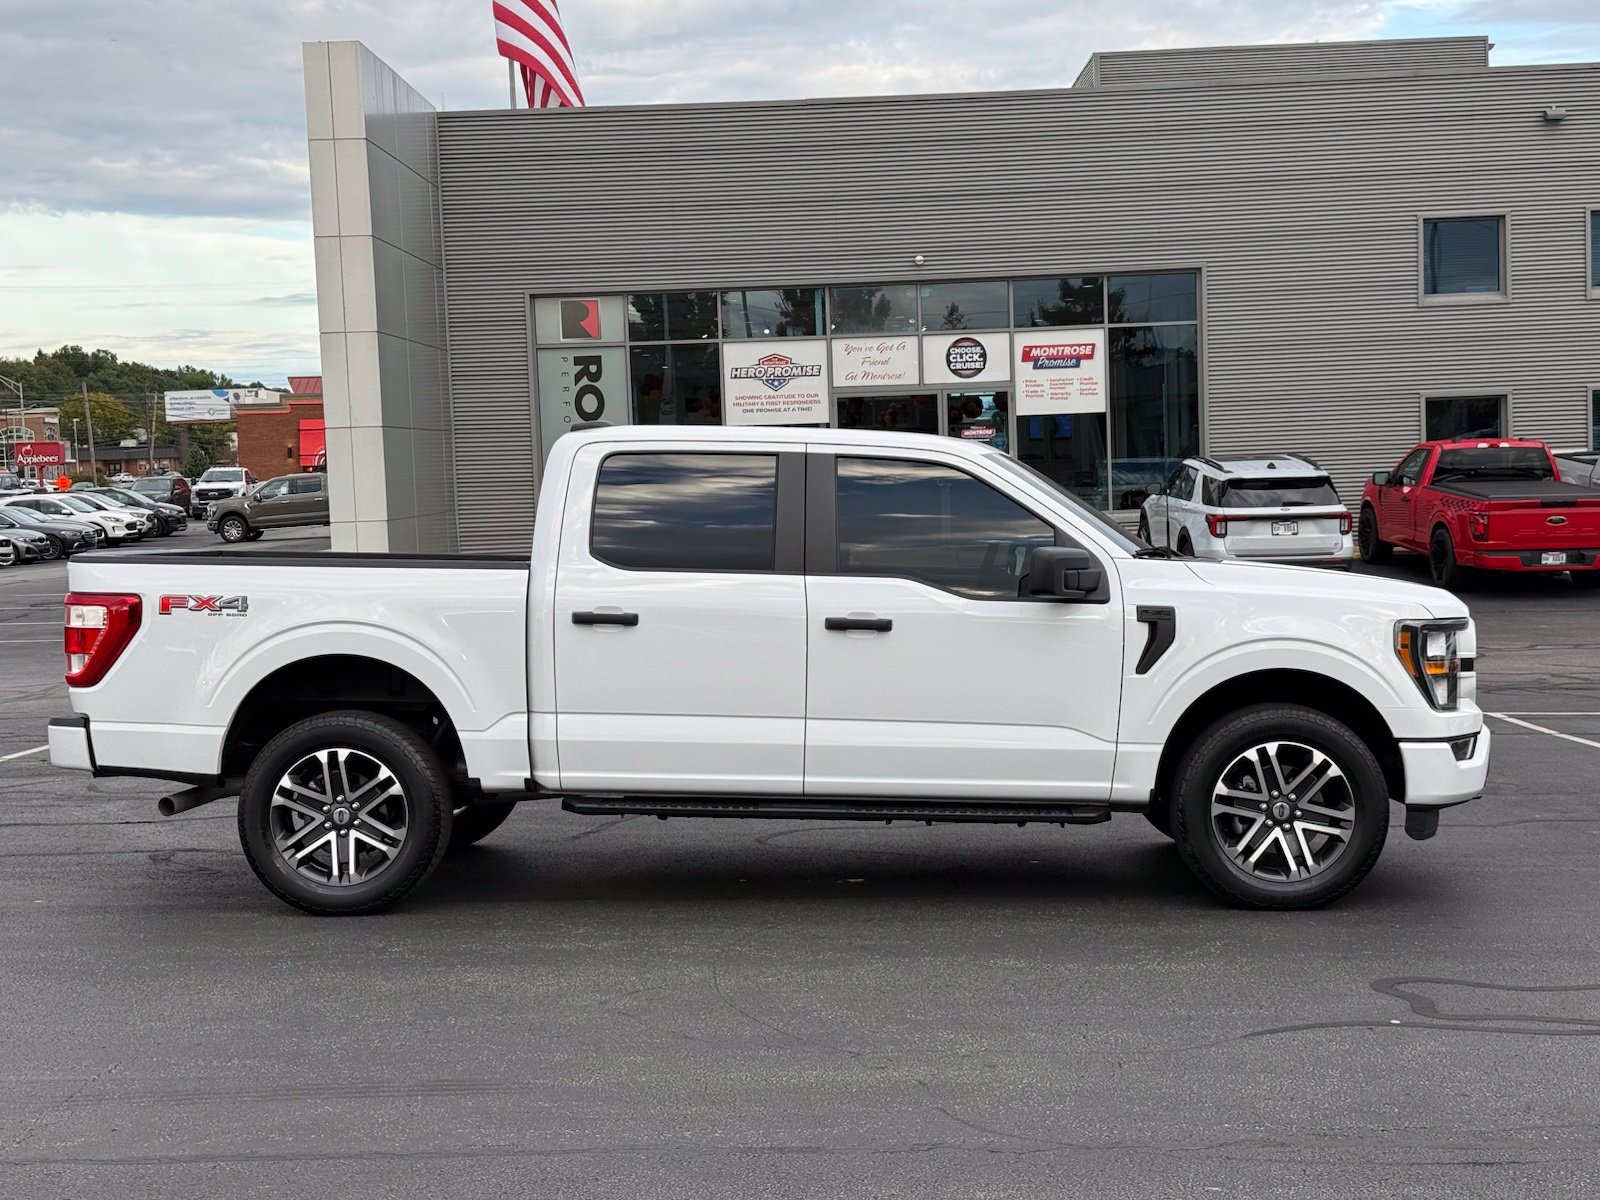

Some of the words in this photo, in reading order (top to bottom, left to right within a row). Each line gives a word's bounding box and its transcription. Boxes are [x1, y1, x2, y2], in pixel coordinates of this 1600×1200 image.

[844, 342, 874, 355] You've
[876, 342, 894, 354] Got
[896, 342, 906, 350] A
[1030, 346, 1092, 356] MONTROSE
[861, 356, 891, 366] Friend
[950, 354, 984, 362] CLICK.
[1037, 356, 1077, 368] Promise
[730, 367, 765, 379] HERO
[766, 365, 822, 378] PROMISE
[844, 372, 858, 380] At
[860, 370, 906, 380] Montrose!
[159, 594, 248, 615] FX4
